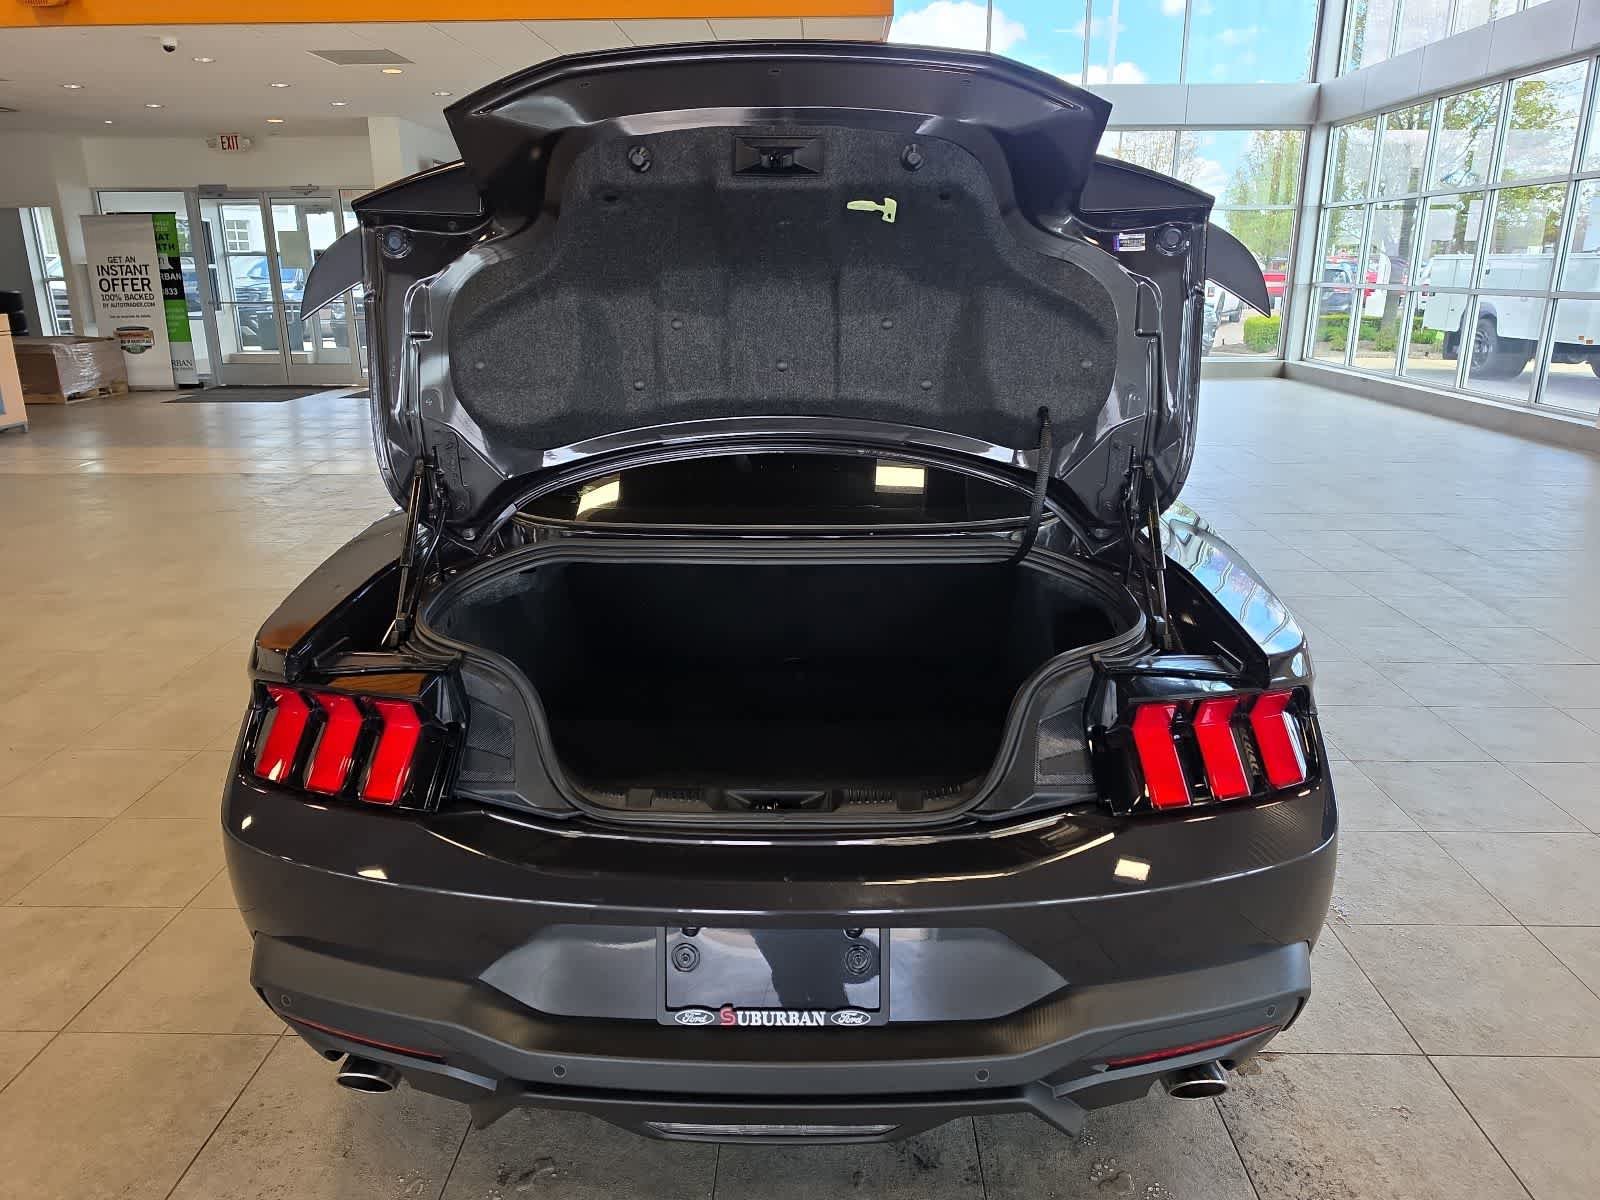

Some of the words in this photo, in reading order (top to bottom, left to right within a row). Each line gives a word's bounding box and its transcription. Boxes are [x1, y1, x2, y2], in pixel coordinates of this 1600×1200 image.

[220, 135, 239, 151] EXIT
[107, 256, 123, 264] GET
[125, 256, 136, 264] AN
[96, 264, 149, 276] INSTANT
[98, 278, 152, 292] OFFER
[101, 294, 122, 302] 100%
[124, 293, 155, 301] BACKED
[681, 1012, 709, 1025] Ford
[720, 1007, 826, 1026] SUBURBAN
[836, 1012, 864, 1025] Ford
